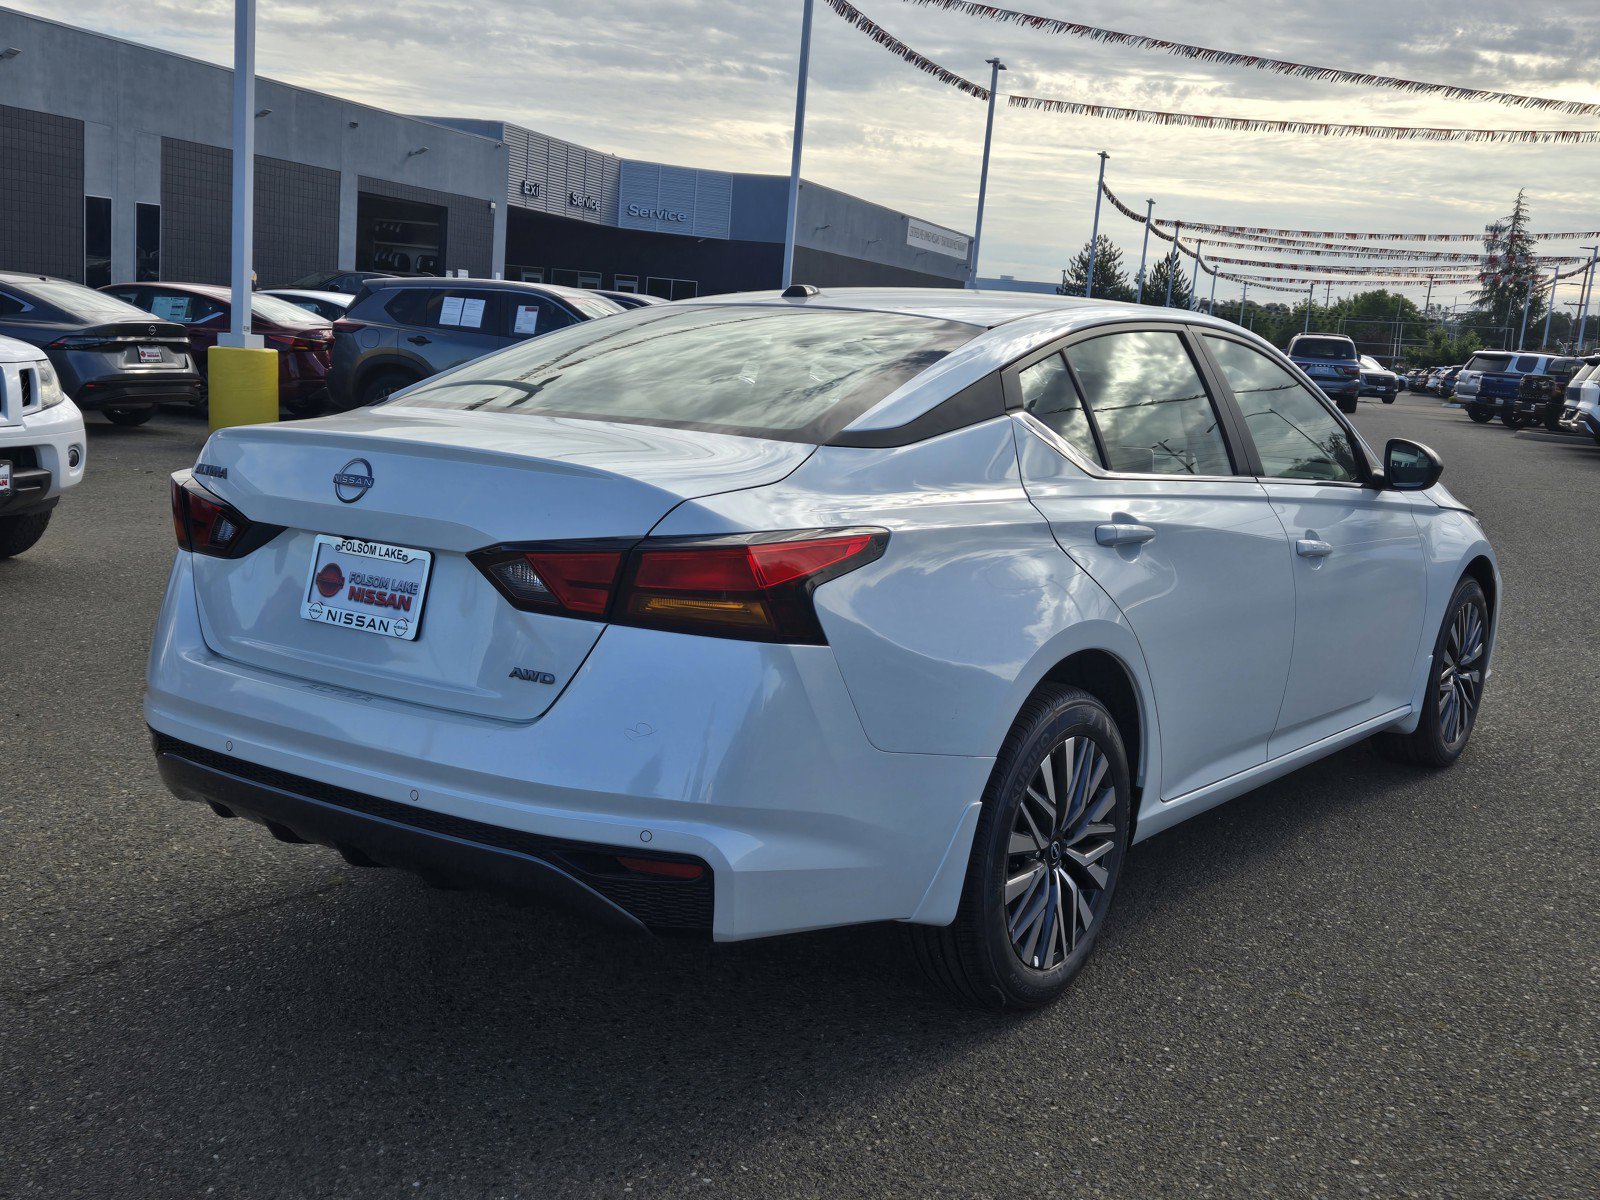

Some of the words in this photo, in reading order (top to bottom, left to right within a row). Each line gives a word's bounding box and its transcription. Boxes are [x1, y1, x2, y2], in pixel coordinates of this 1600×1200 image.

[571, 191, 602, 212] Service
[628, 202, 688, 222] Service
[194, 463, 228, 480] ALTIMA
[334, 474, 373, 487] NISSAN
[341, 540, 377, 556] FOLSOM
[378, 546, 403, 561] LAKE
[348, 571, 390, 589] FOLSOM
[391, 579, 420, 595] LAKE
[347, 585, 413, 612] NISSAN
[326, 609, 390, 633] NISSAN
[508, 666, 556, 685] AWD
